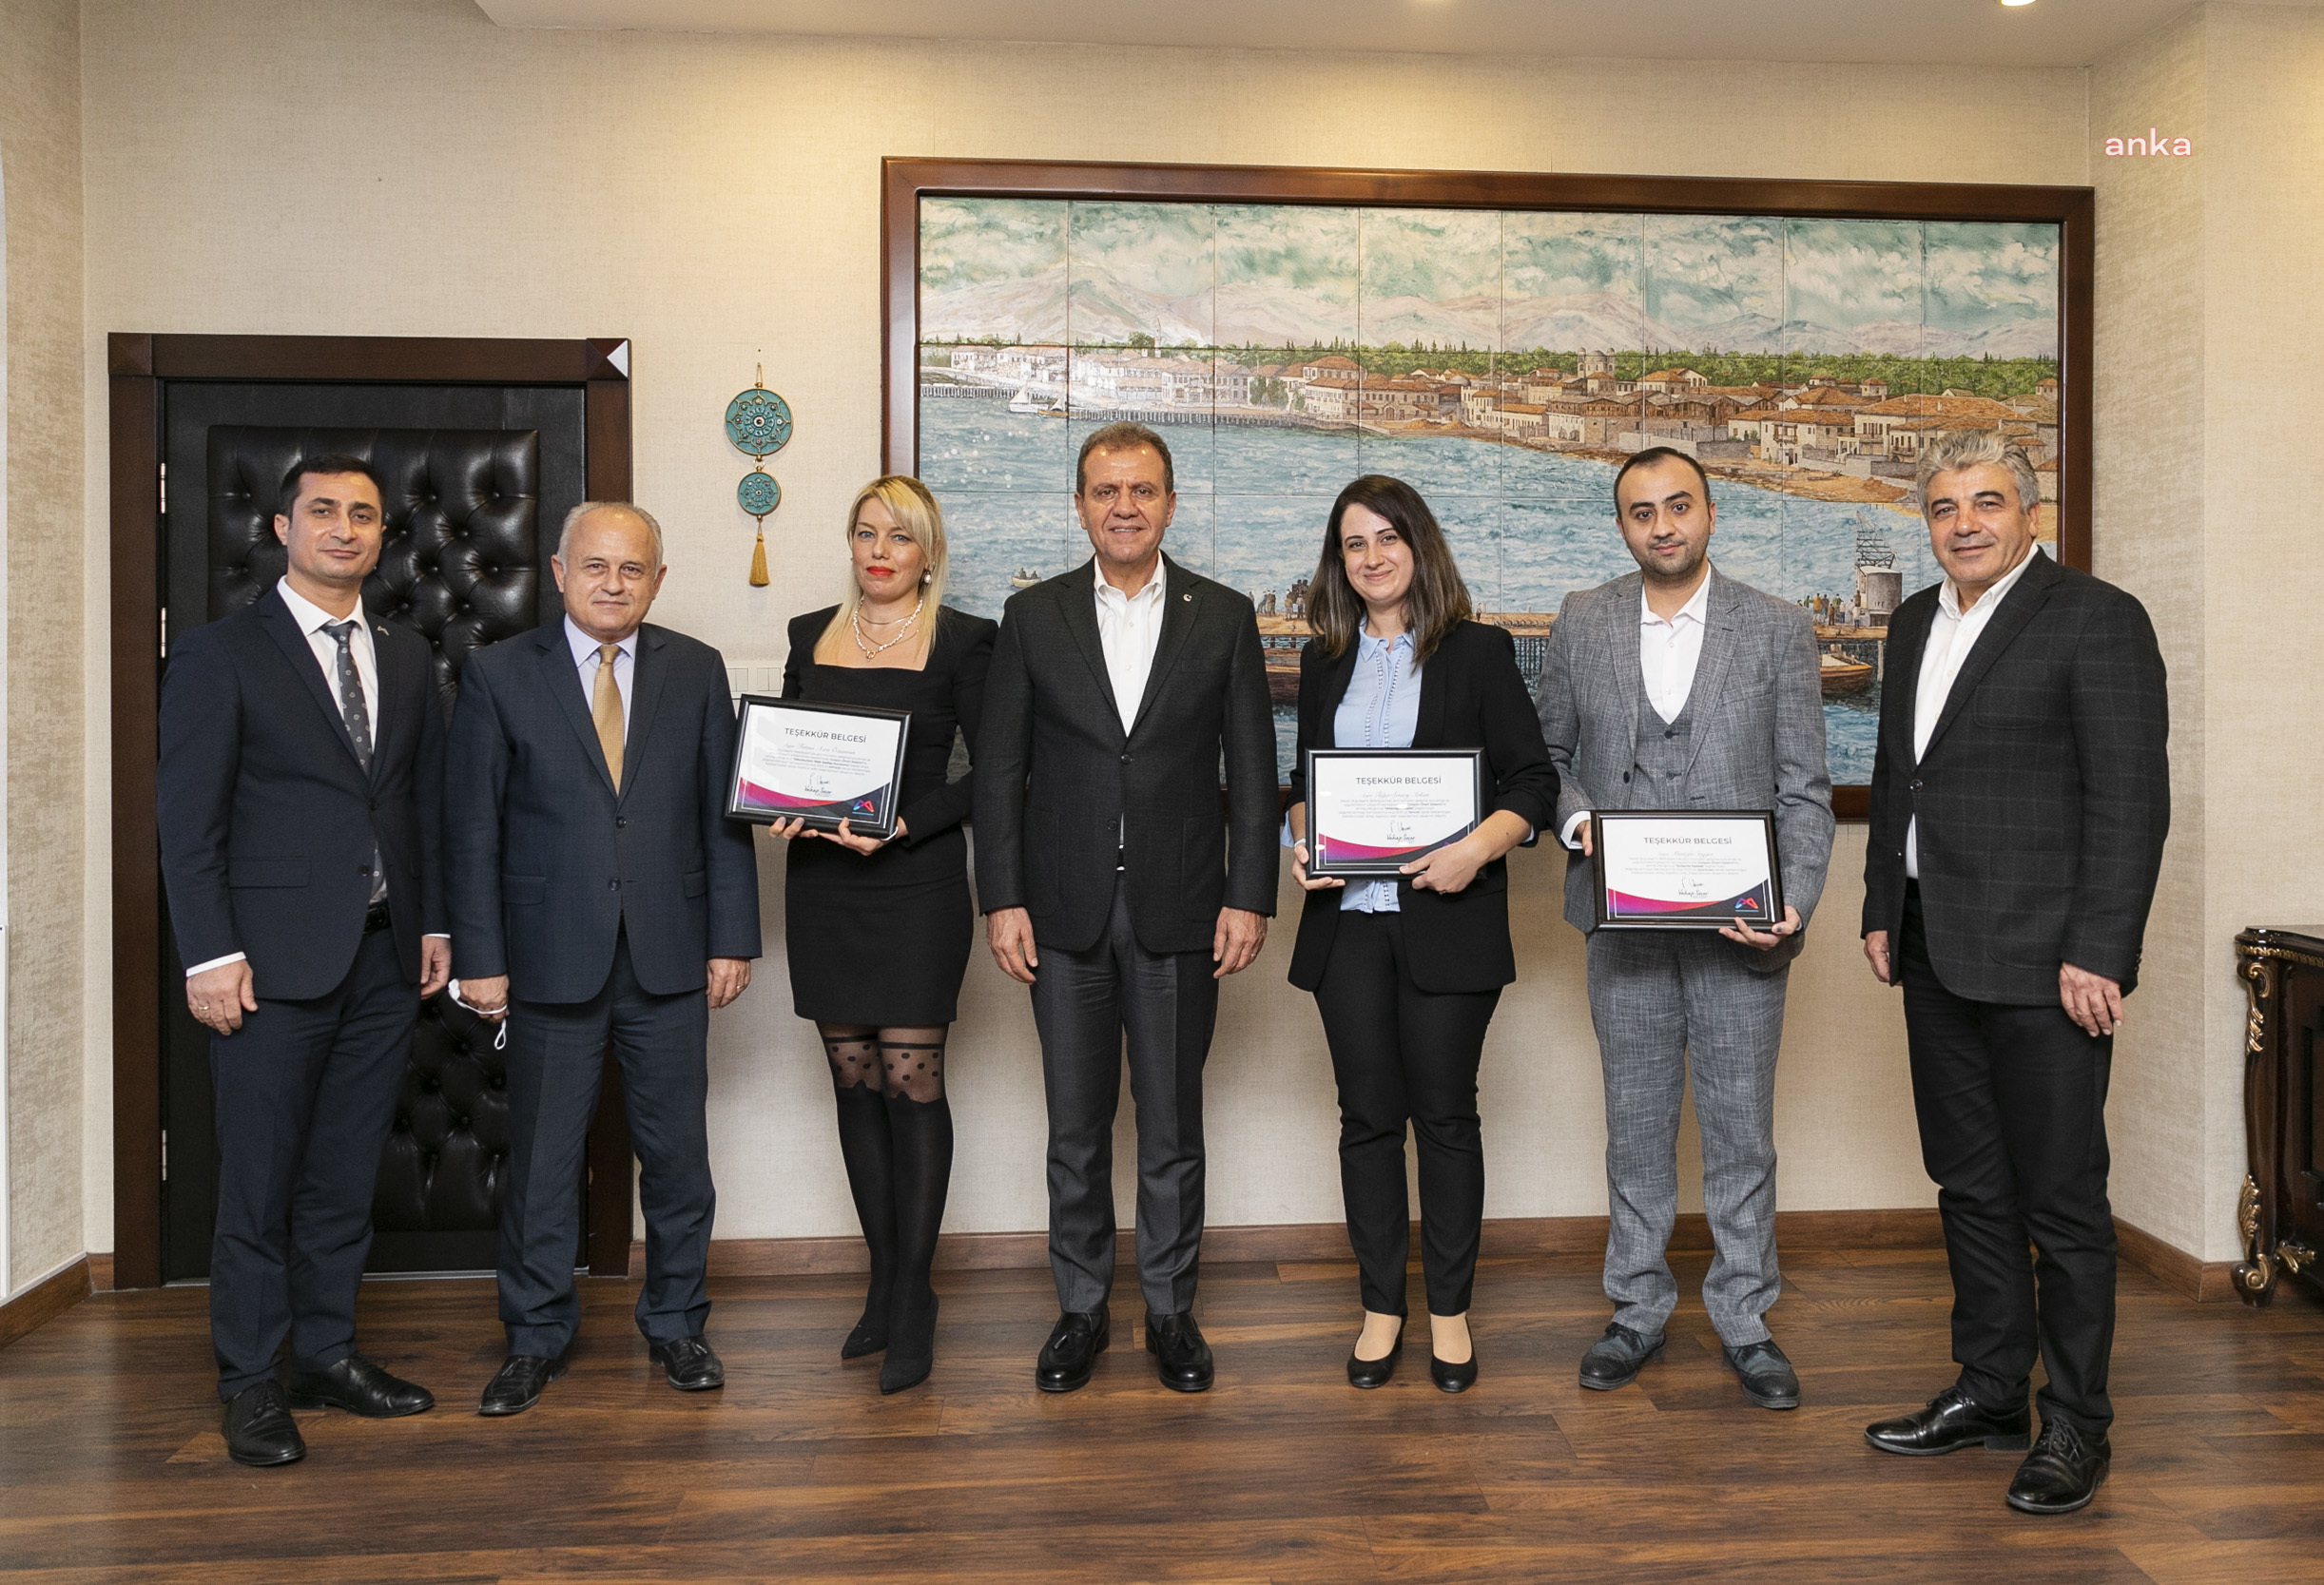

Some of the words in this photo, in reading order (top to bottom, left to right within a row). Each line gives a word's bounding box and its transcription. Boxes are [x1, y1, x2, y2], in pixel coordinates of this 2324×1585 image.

[784, 727, 829, 739] TEŞEKKÜR
[830, 732, 867, 744] BELGESİ
[1356, 776, 1403, 785] TEŞEKKÜR
[1404, 776, 1442, 784] BELGESİ
[1643, 837, 1692, 845] TEŞEKKÜR
